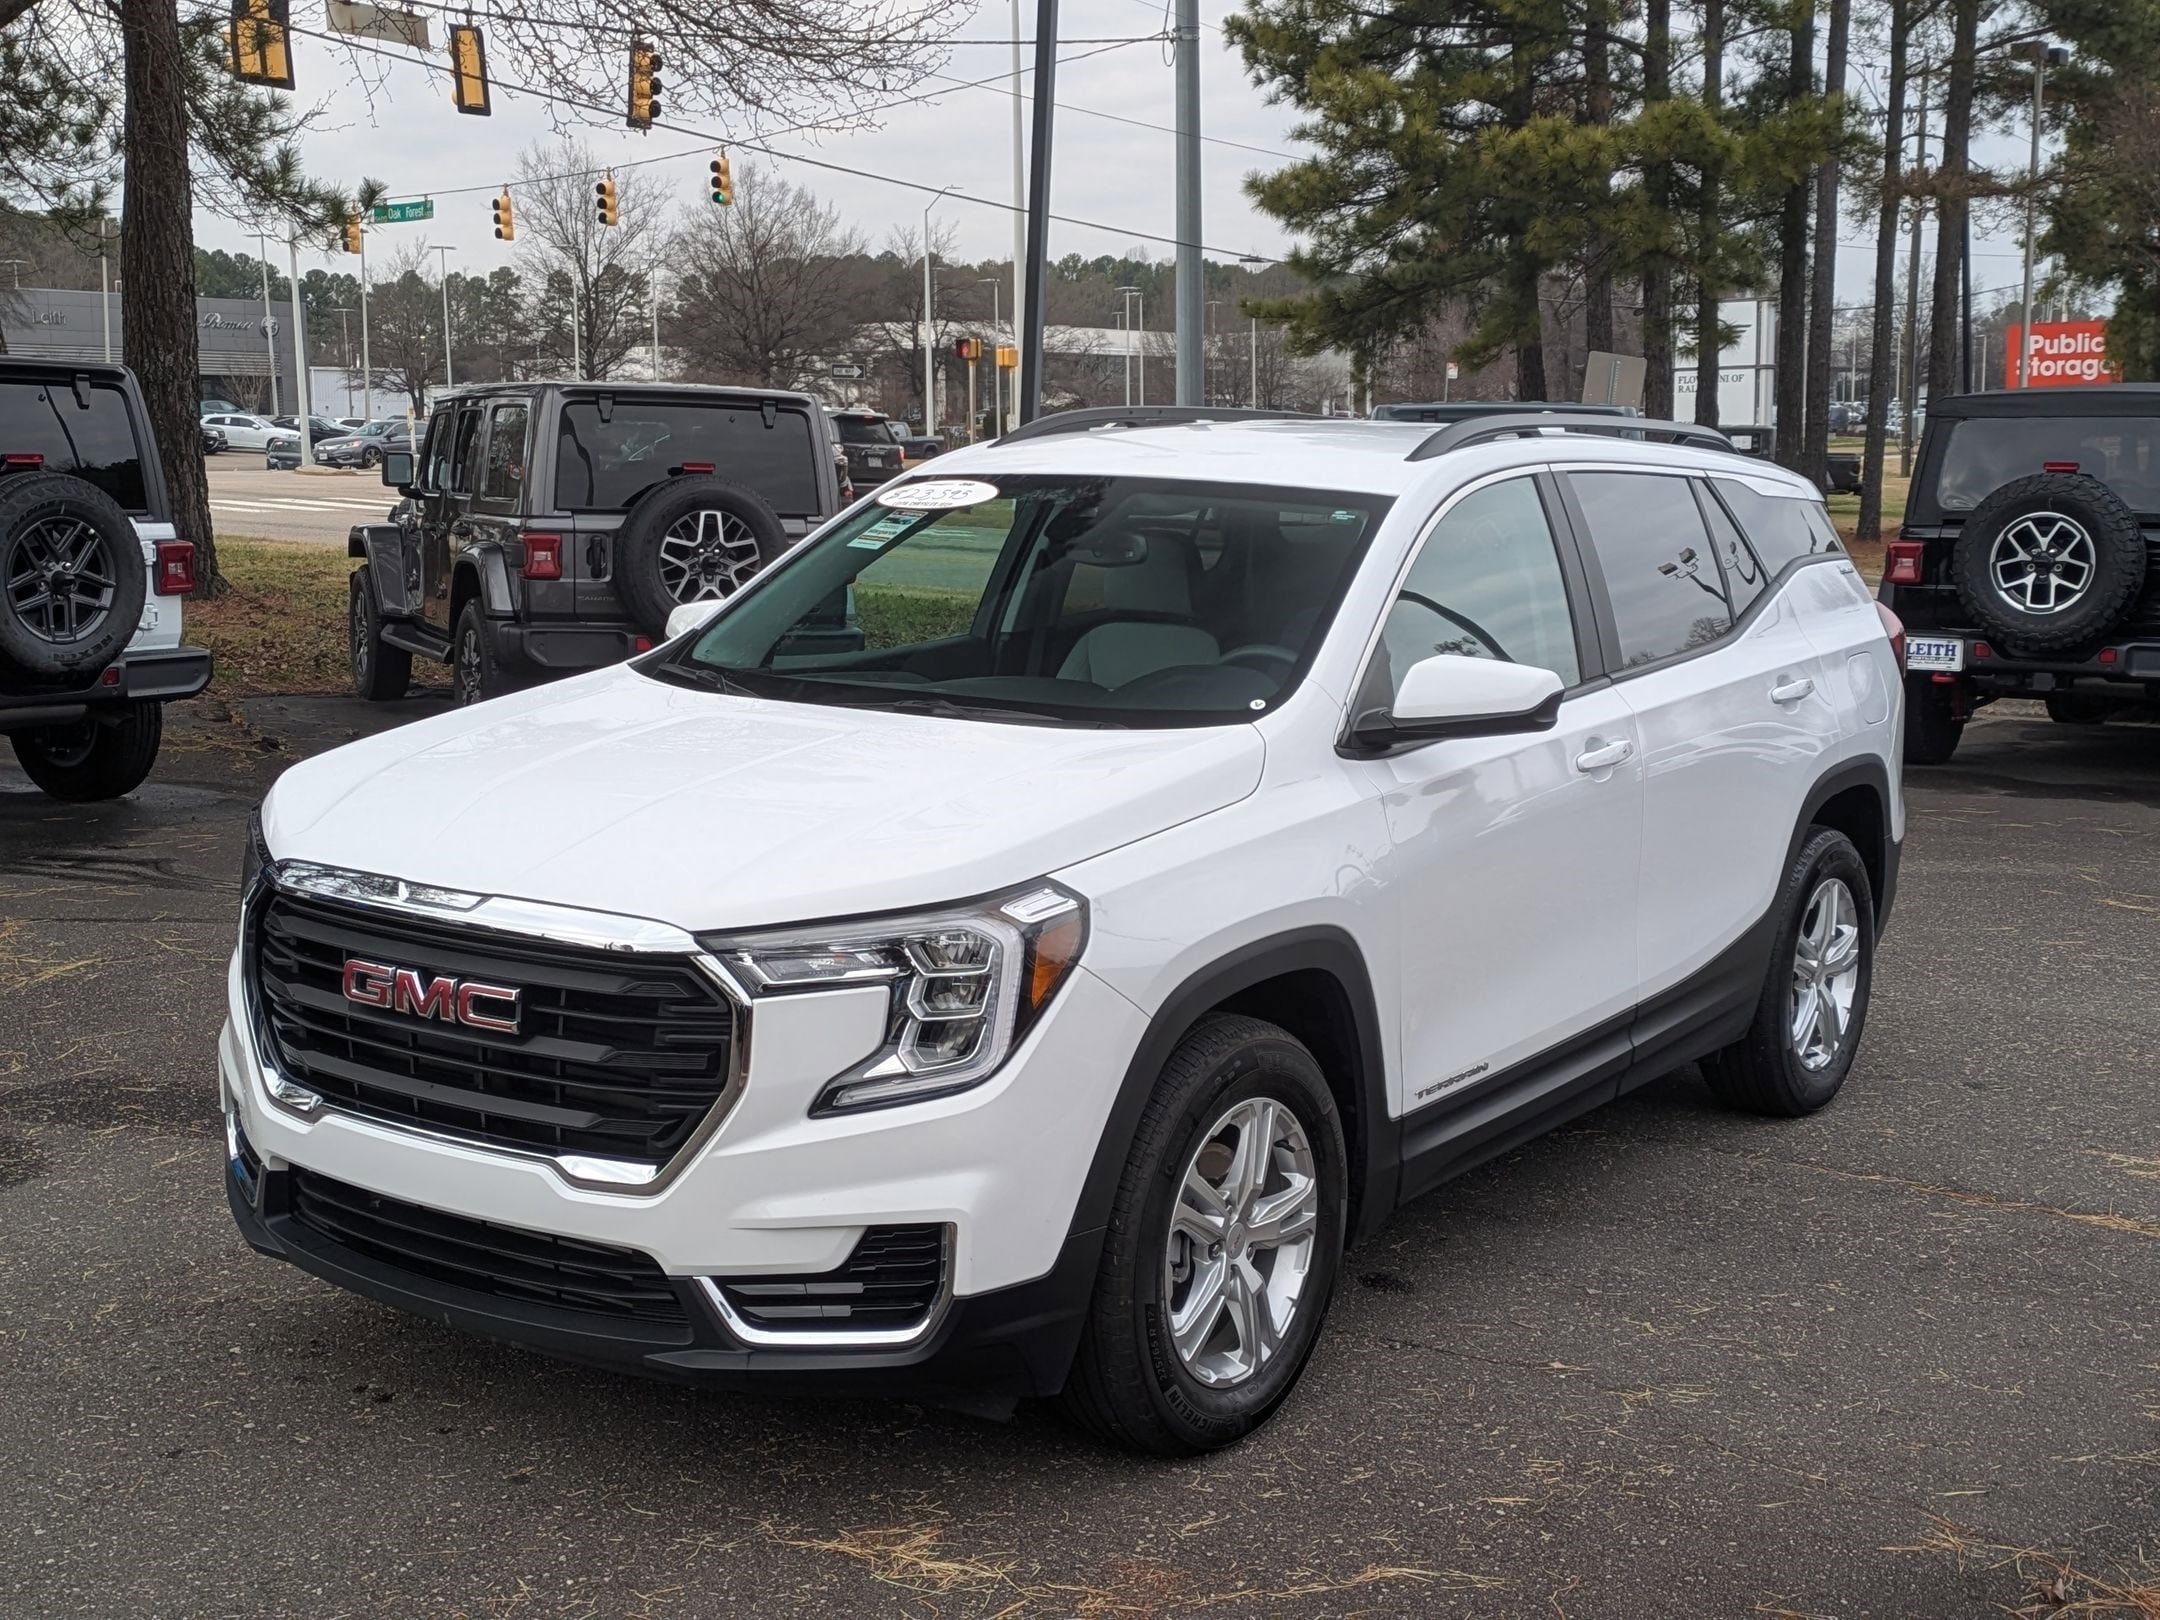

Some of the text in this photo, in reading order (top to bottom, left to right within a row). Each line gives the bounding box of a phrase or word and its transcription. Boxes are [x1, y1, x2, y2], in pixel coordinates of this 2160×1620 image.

[388, 207, 401, 219] Oak
[405, 205, 424, 218] Forest
[32, 310, 66, 324] Leith
[2028, 332, 2106, 355] Public
[1731, 374, 1744, 383] OF
[1907, 643, 1957, 656] LEITH
[342, 959, 521, 1035] GMC
